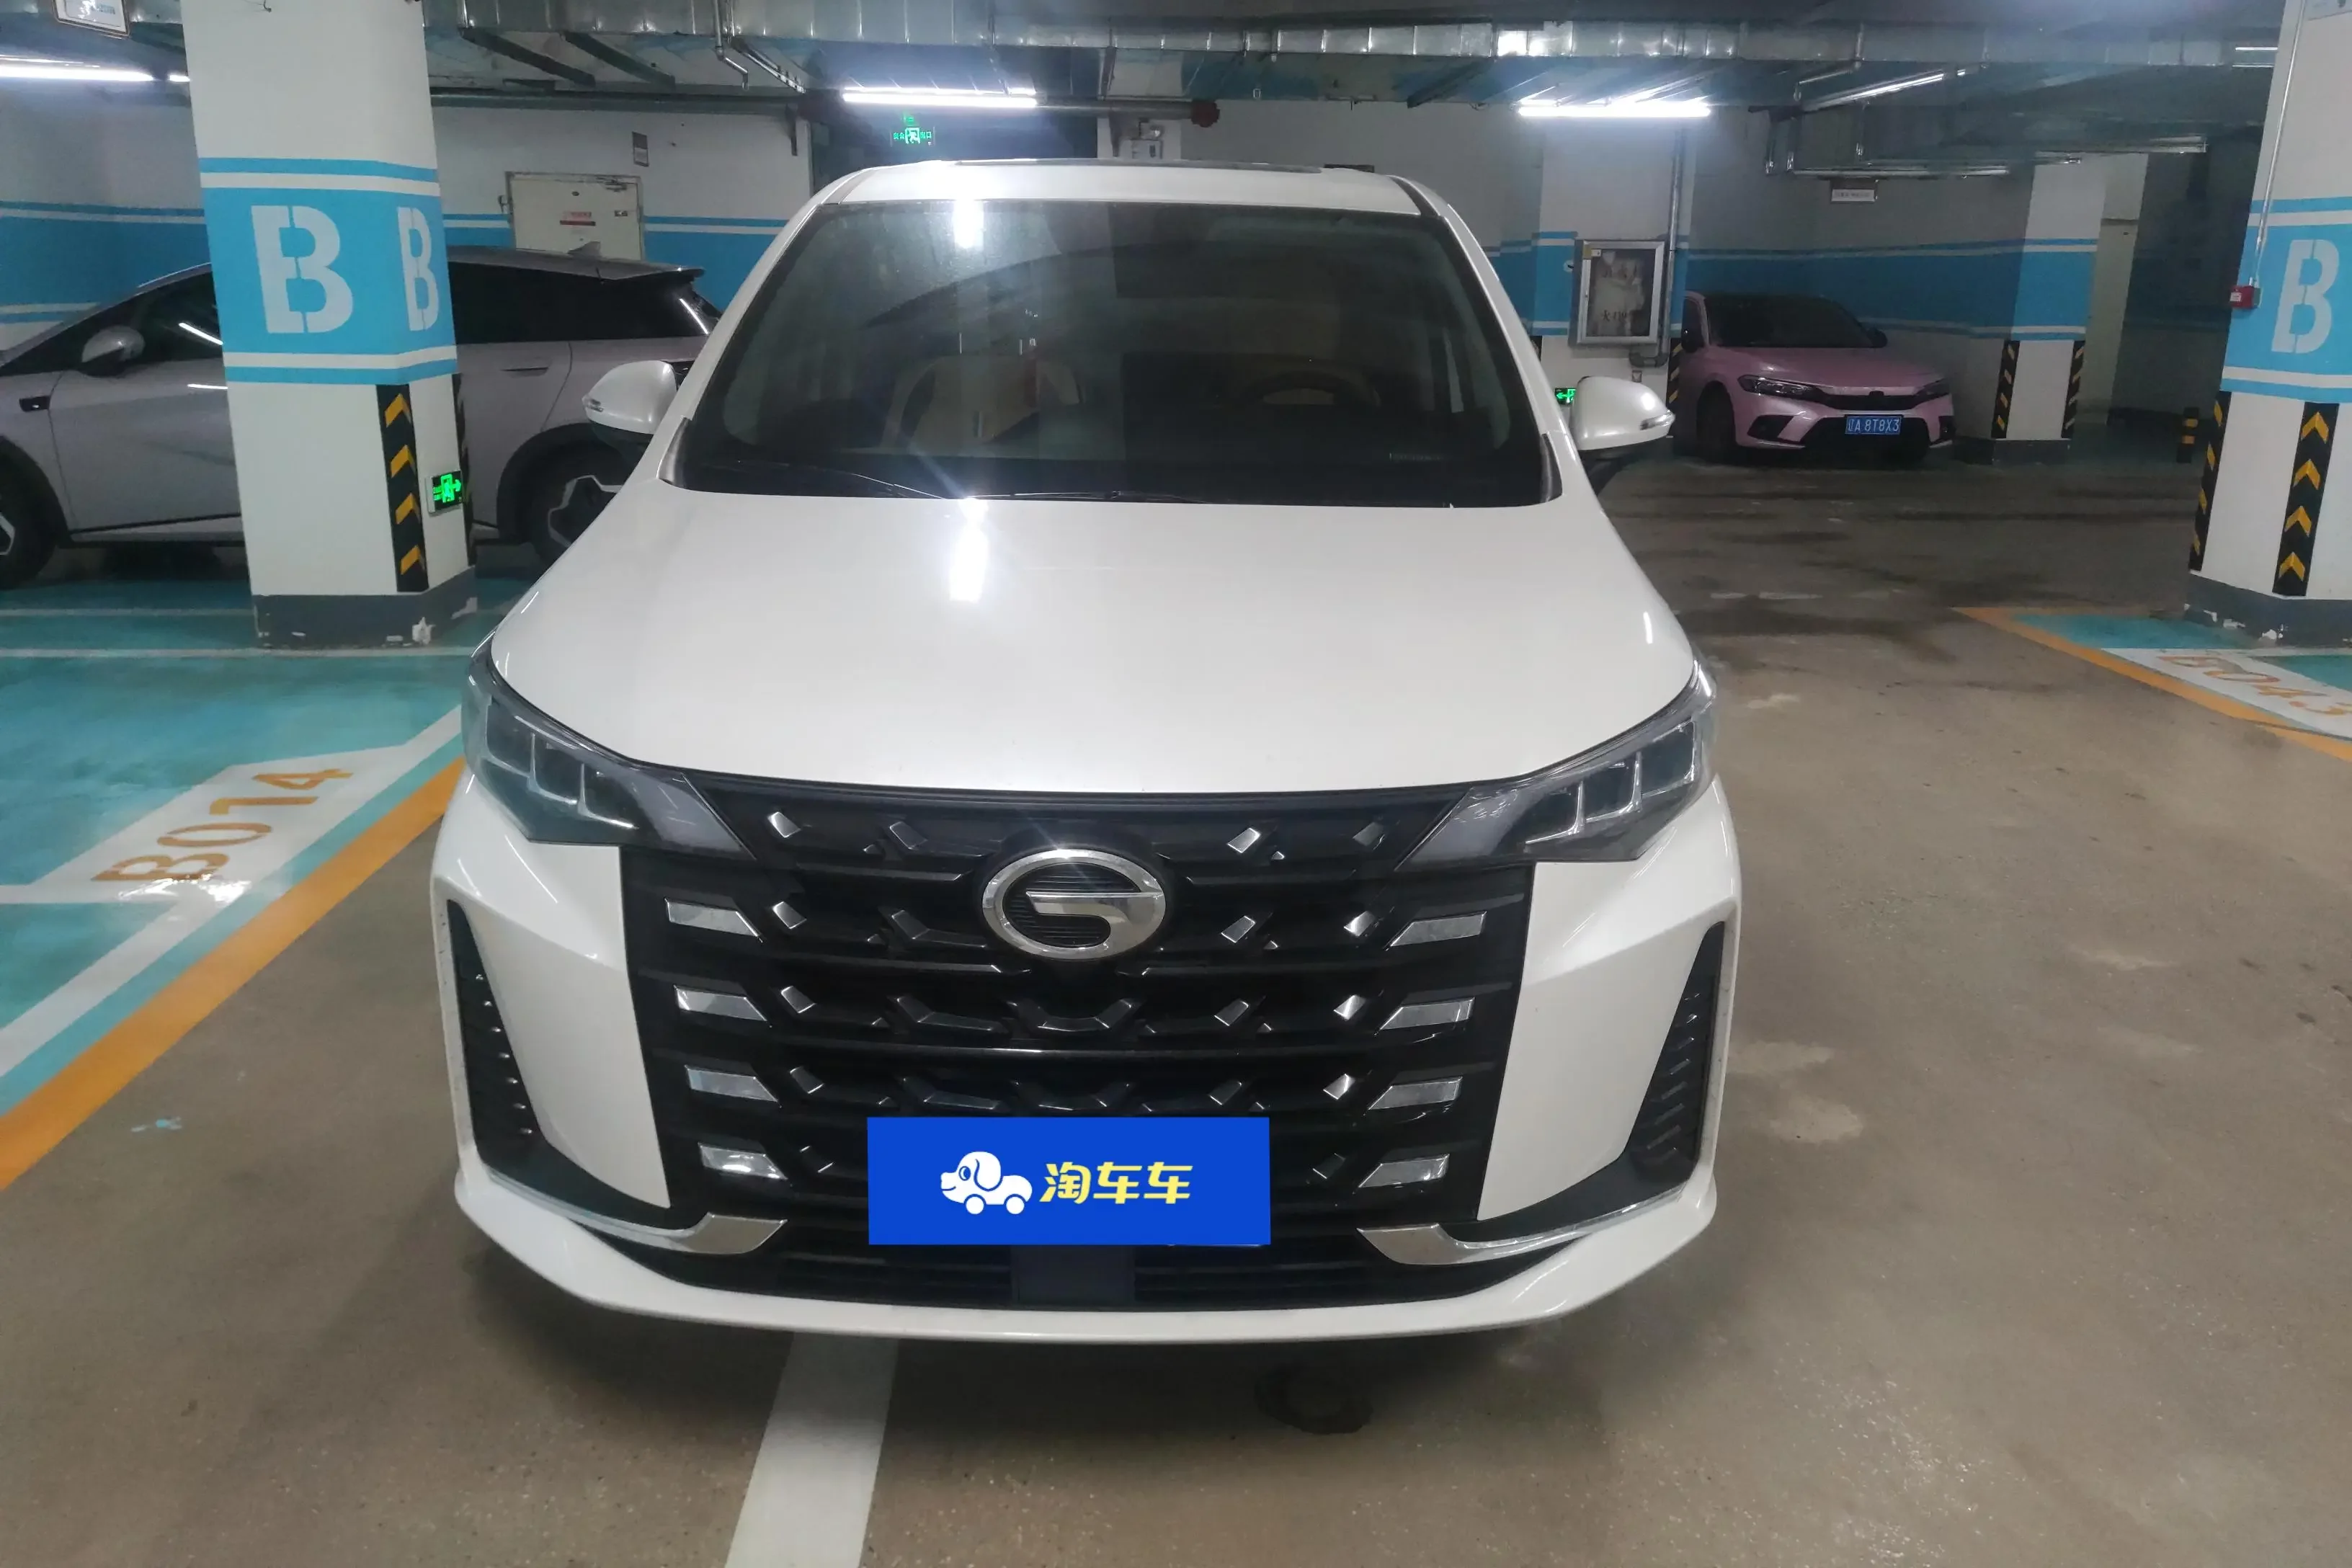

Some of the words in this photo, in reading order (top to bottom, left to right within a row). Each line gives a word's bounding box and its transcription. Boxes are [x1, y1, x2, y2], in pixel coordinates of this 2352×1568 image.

[251, 205, 353, 334] B
[397, 207, 439, 331] B
[2271, 239, 2339, 354] B
[91, 768, 354, 881] B014
